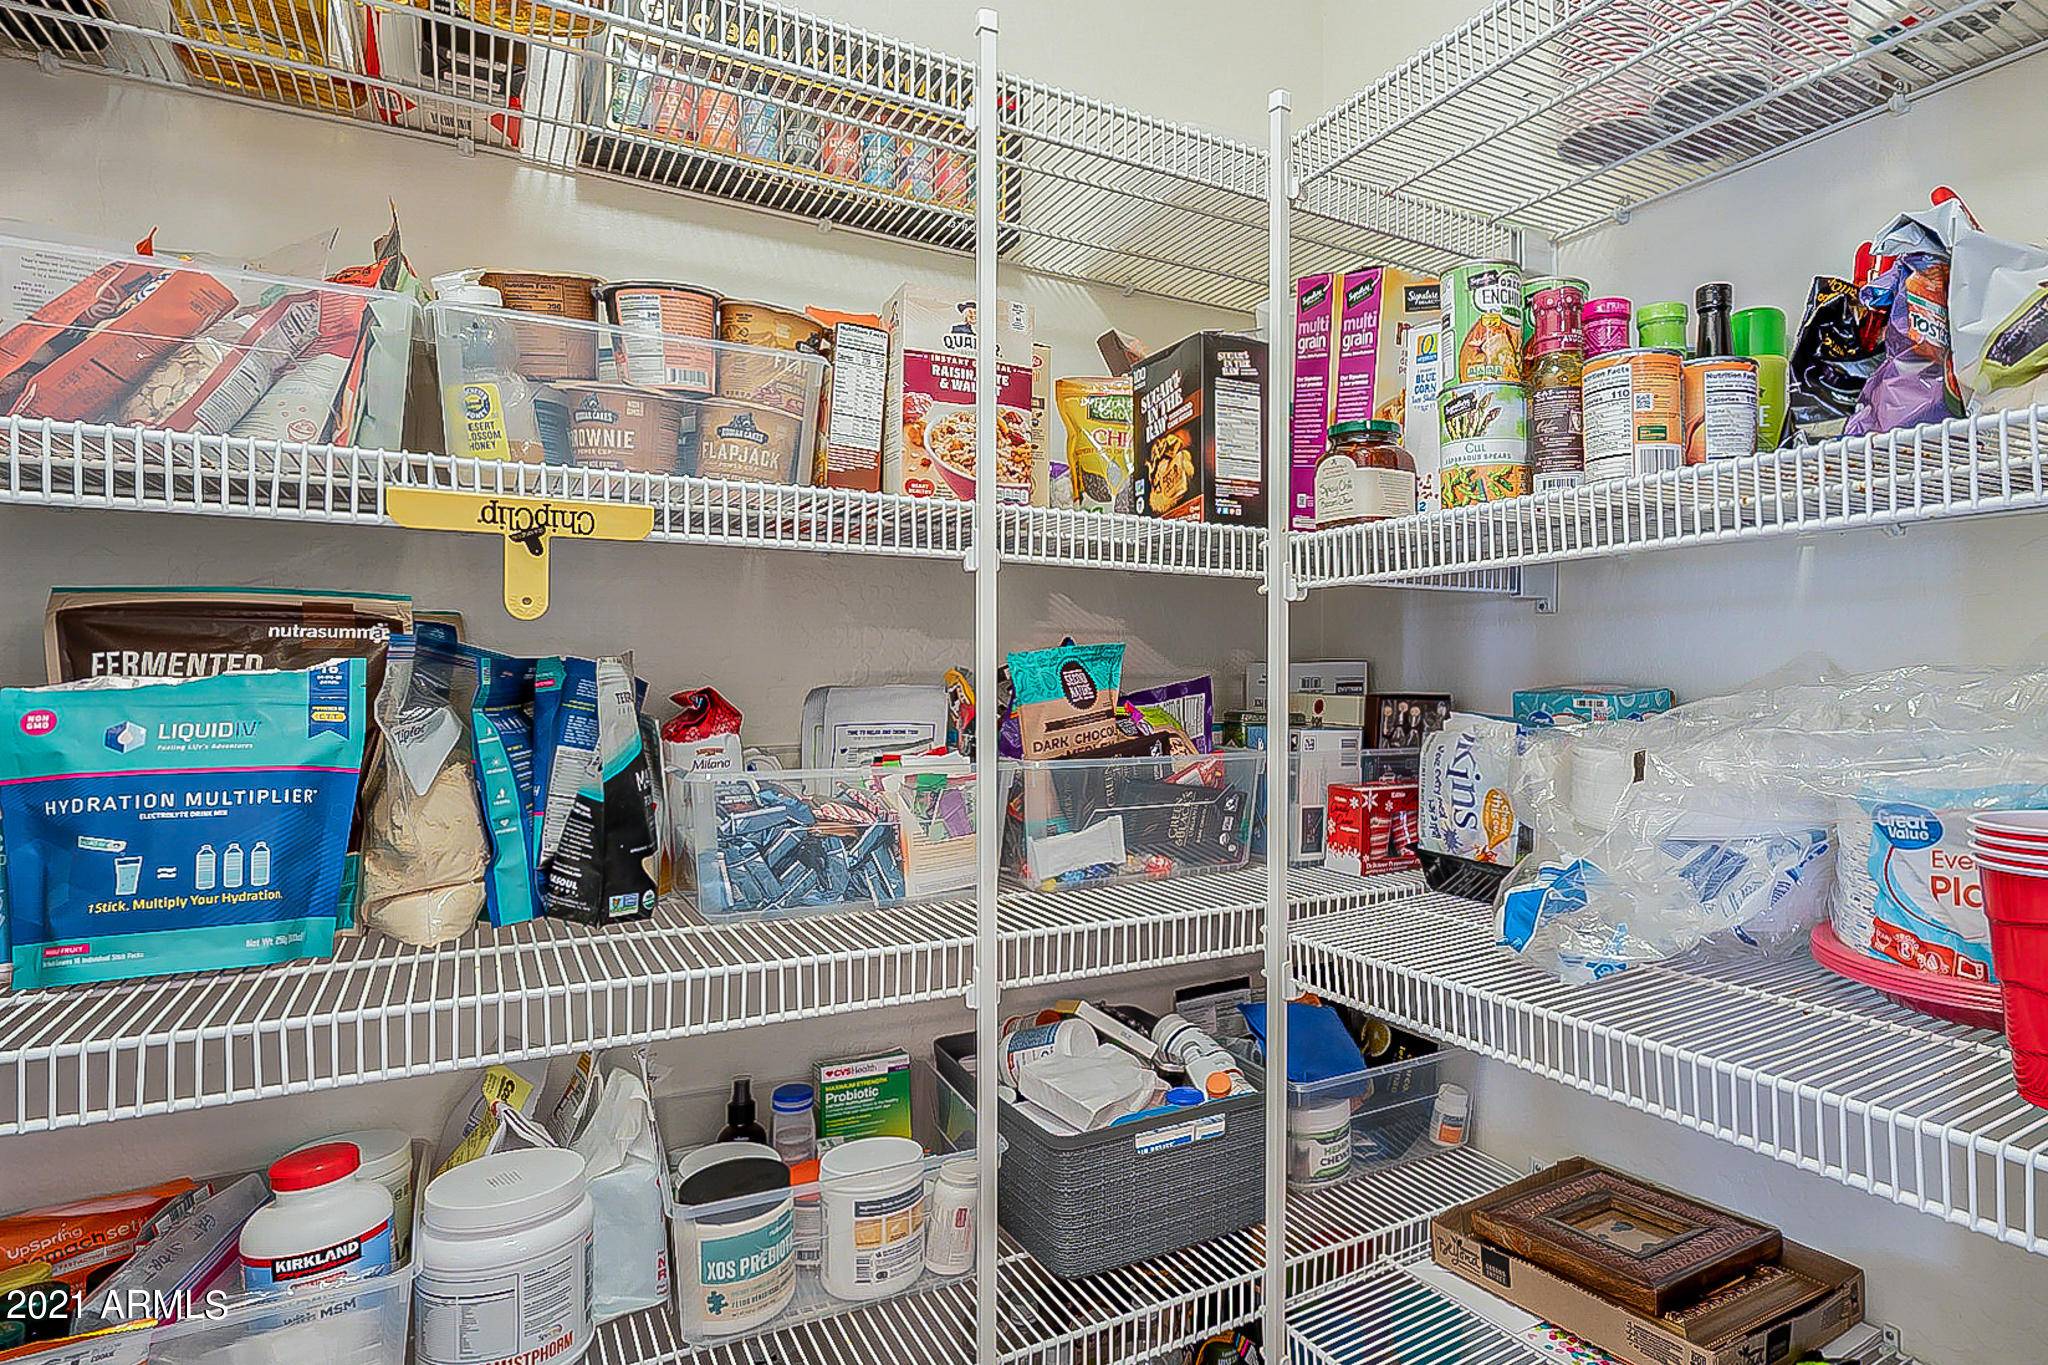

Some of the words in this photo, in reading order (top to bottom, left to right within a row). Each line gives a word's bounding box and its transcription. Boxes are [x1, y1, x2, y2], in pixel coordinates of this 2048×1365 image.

[1298, 315, 1330, 335] multi
[1343, 311, 1377, 332] multi
[1297, 333, 1327, 354] grain
[1342, 330, 1374, 352] grain
[930, 353, 969, 367] INSTANT
[1415, 372, 1437, 383] BLUE
[1414, 383, 1437, 395] CORN
[1611, 389, 1630, 399] 110
[1706, 396, 1739, 404] Calories
[570, 427, 635, 449] ROWNIE
[702, 441, 780, 469] FLAPJACK
[91, 650, 263, 678] FERMENTED
[26, 714, 50, 724] NON
[26, 721, 50, 731] GMO
[158, 721, 235, 740] LIQUID
[211, 742, 253, 751] Adventures
[1033, 735, 1069, 753] DARK
[690, 757, 731, 770] Milano
[45, 791, 176, 816] HYDRATION
[185, 788, 314, 806] MULTIPLIER
[139, 810, 188, 820] ELECTROLYTE
[190, 809, 213, 818] DRINK
[1877, 809, 1929, 830] Great
[1888, 825, 1929, 841] Value
[133, 896, 188, 912] Multiply
[190, 893, 218, 907] Your
[222, 890, 283, 905] Hydration.
[834, 1067, 851, 1077] CVS
[825, 1086, 879, 1104] Probiotic
[275, 1241, 360, 1273] KIRKLAND
[707, 1260, 736, 1280] XOS
[320, 1297, 357, 1320] MSM
